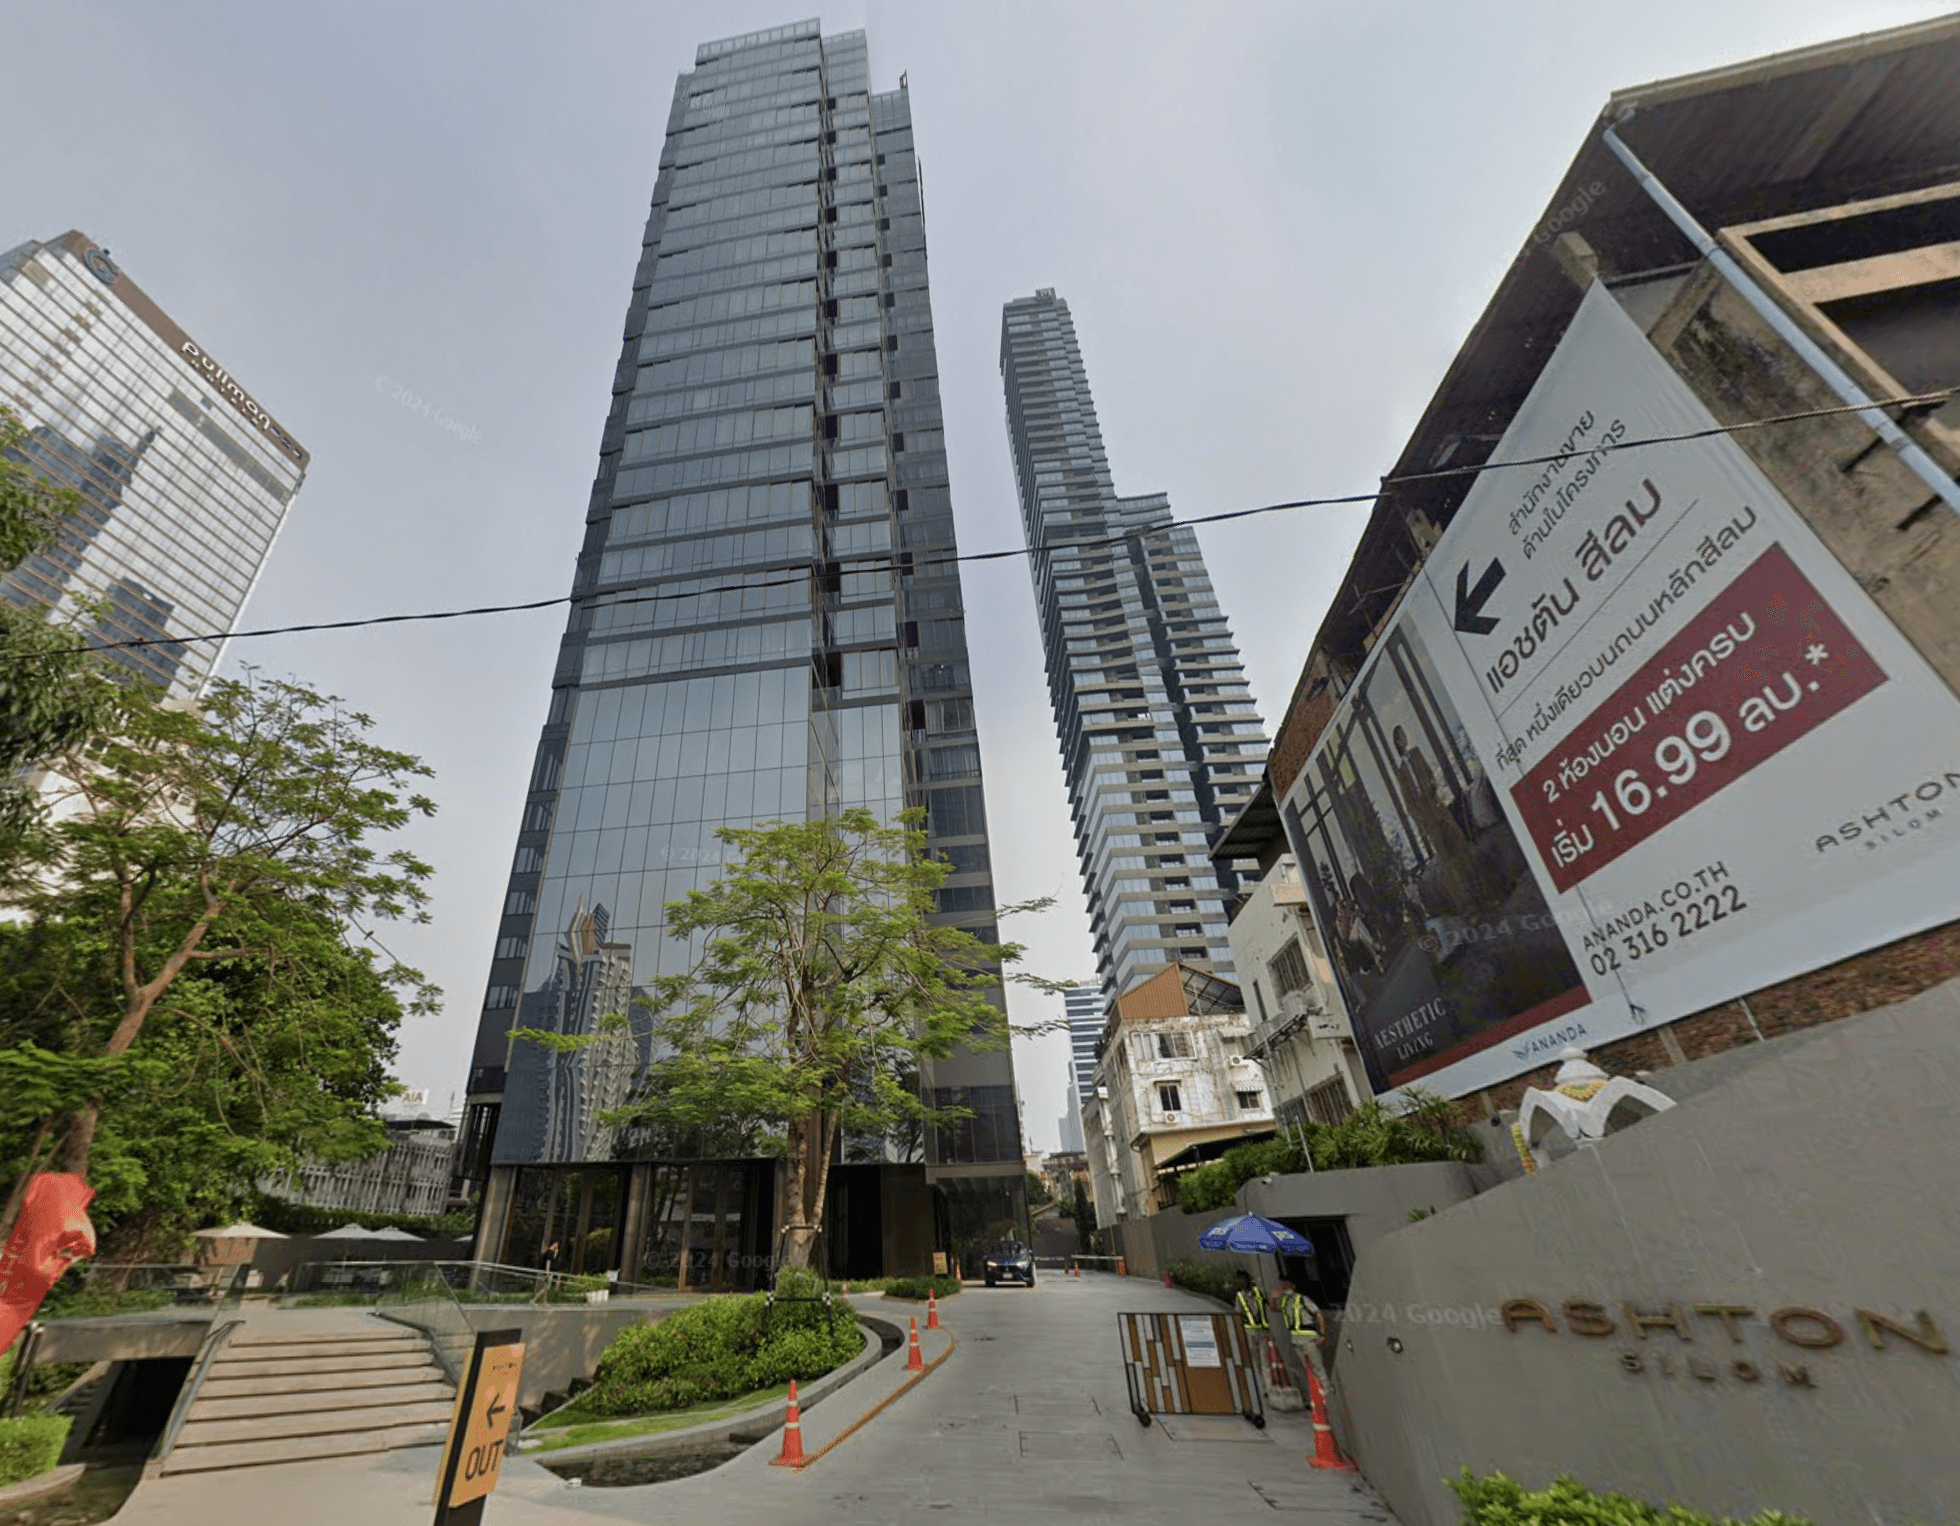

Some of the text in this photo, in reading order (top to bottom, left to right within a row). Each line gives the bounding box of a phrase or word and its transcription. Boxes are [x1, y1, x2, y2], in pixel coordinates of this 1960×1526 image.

[1522, 419, 1626, 560] ด้านในโครงการ
[1486, 478, 1662, 694] แอชตัน สีลม
[1542, 611, 1757, 802] 2 ห้องนอน แต่งครบ
[1552, 819, 1594, 867] เริ่ม
[1591, 710, 1732, 831] 16.99
[1582, 861, 1730, 951] ANANDA.CO.TH
[1590, 884, 1748, 976] 02 316 2222
[1374, 998, 1447, 1049] AESTHETIC
[1396, 1031, 1434, 1061] LIVING
[1531, 1023, 1587, 1054] ANANDA
[1501, 1297, 1949, 1355] ASHTON
[465, 1439, 504, 1482] OUT
